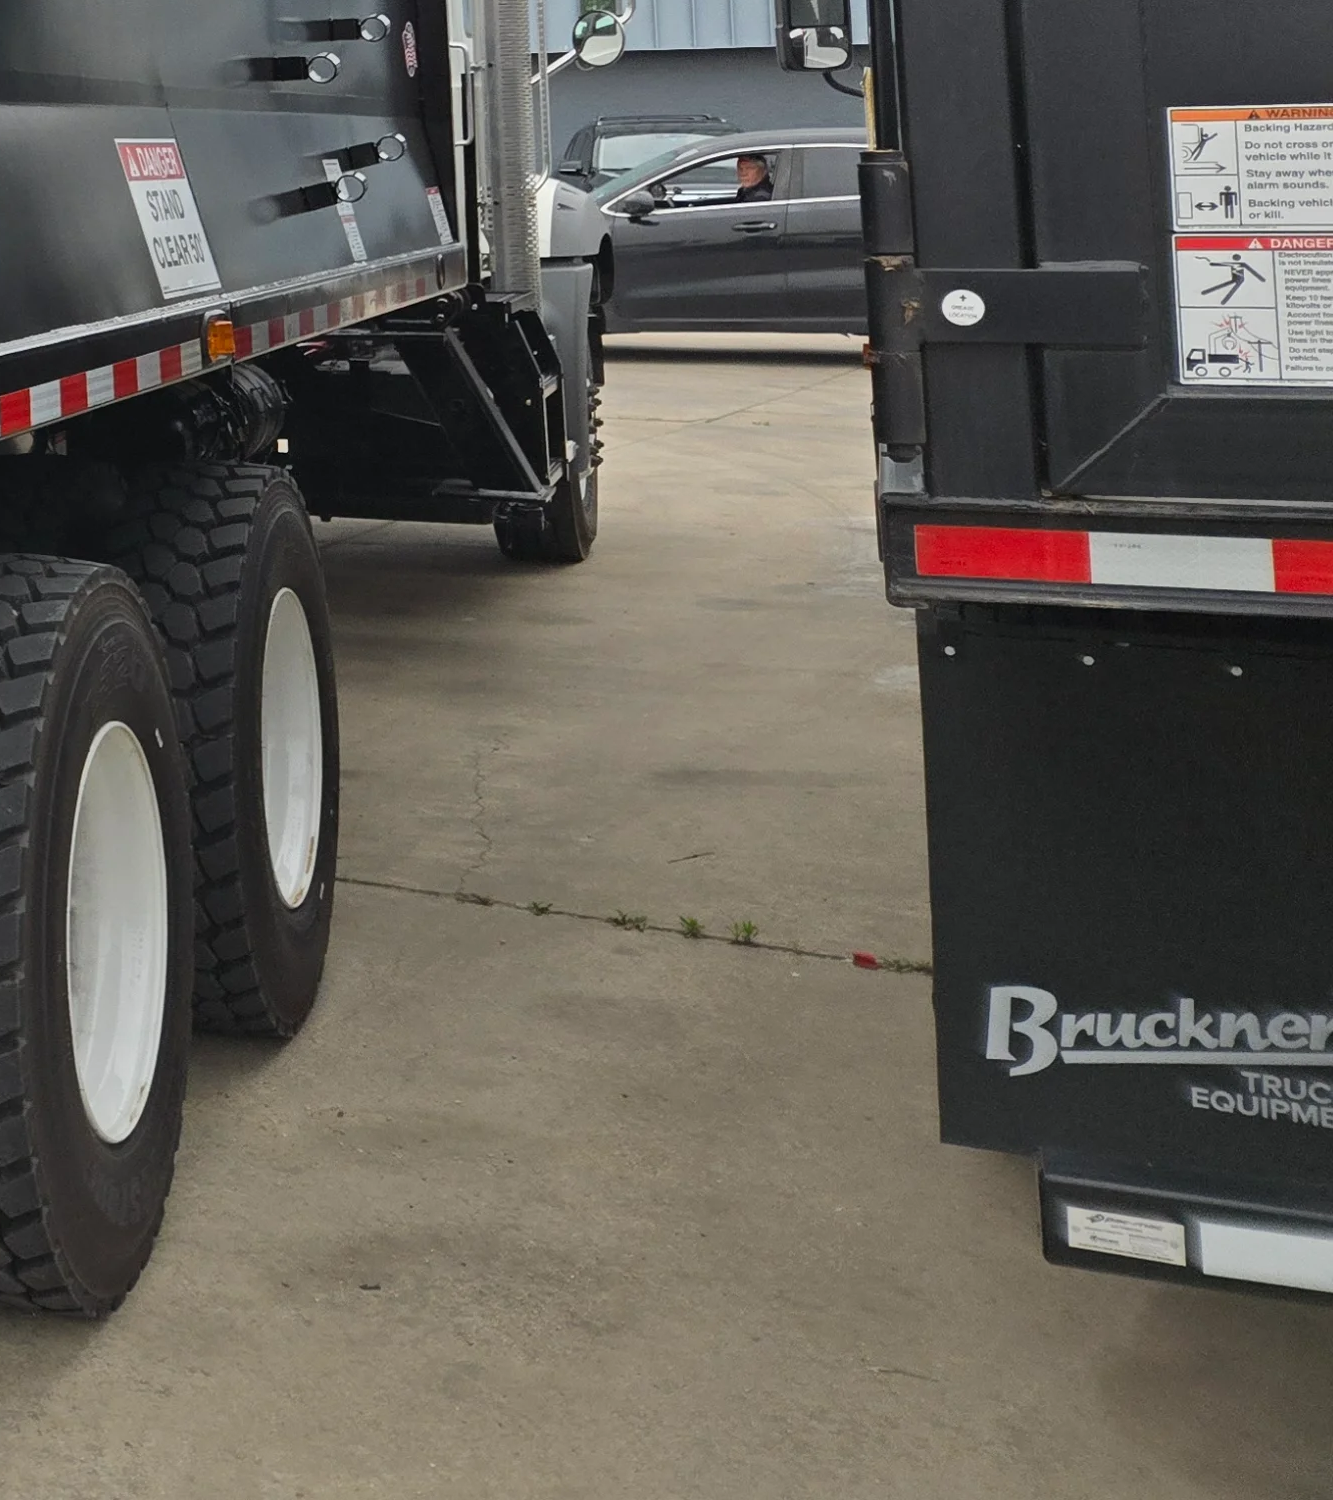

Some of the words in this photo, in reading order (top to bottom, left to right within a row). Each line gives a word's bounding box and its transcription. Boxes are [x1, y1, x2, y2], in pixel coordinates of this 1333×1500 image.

[1244, 124, 1290, 133] Backing
[1245, 141, 1261, 149] Do
[1264, 141, 1283, 149] not
[1245, 153, 1287, 161] vehicle
[1289, 152, 1321, 160] while
[1324, 152, 1332, 160] it
[136, 147, 181, 178] DANGER
[1246, 169, 1272, 179] Stay
[1275, 170, 1305, 179] away
[1282, 181, 1329, 189] sounds.
[146, 189, 185, 222] STAND
[1248, 199, 1295, 209] Backing
[1264, 211, 1284, 219] kill.
[153, 234, 192, 269] CLEAR
